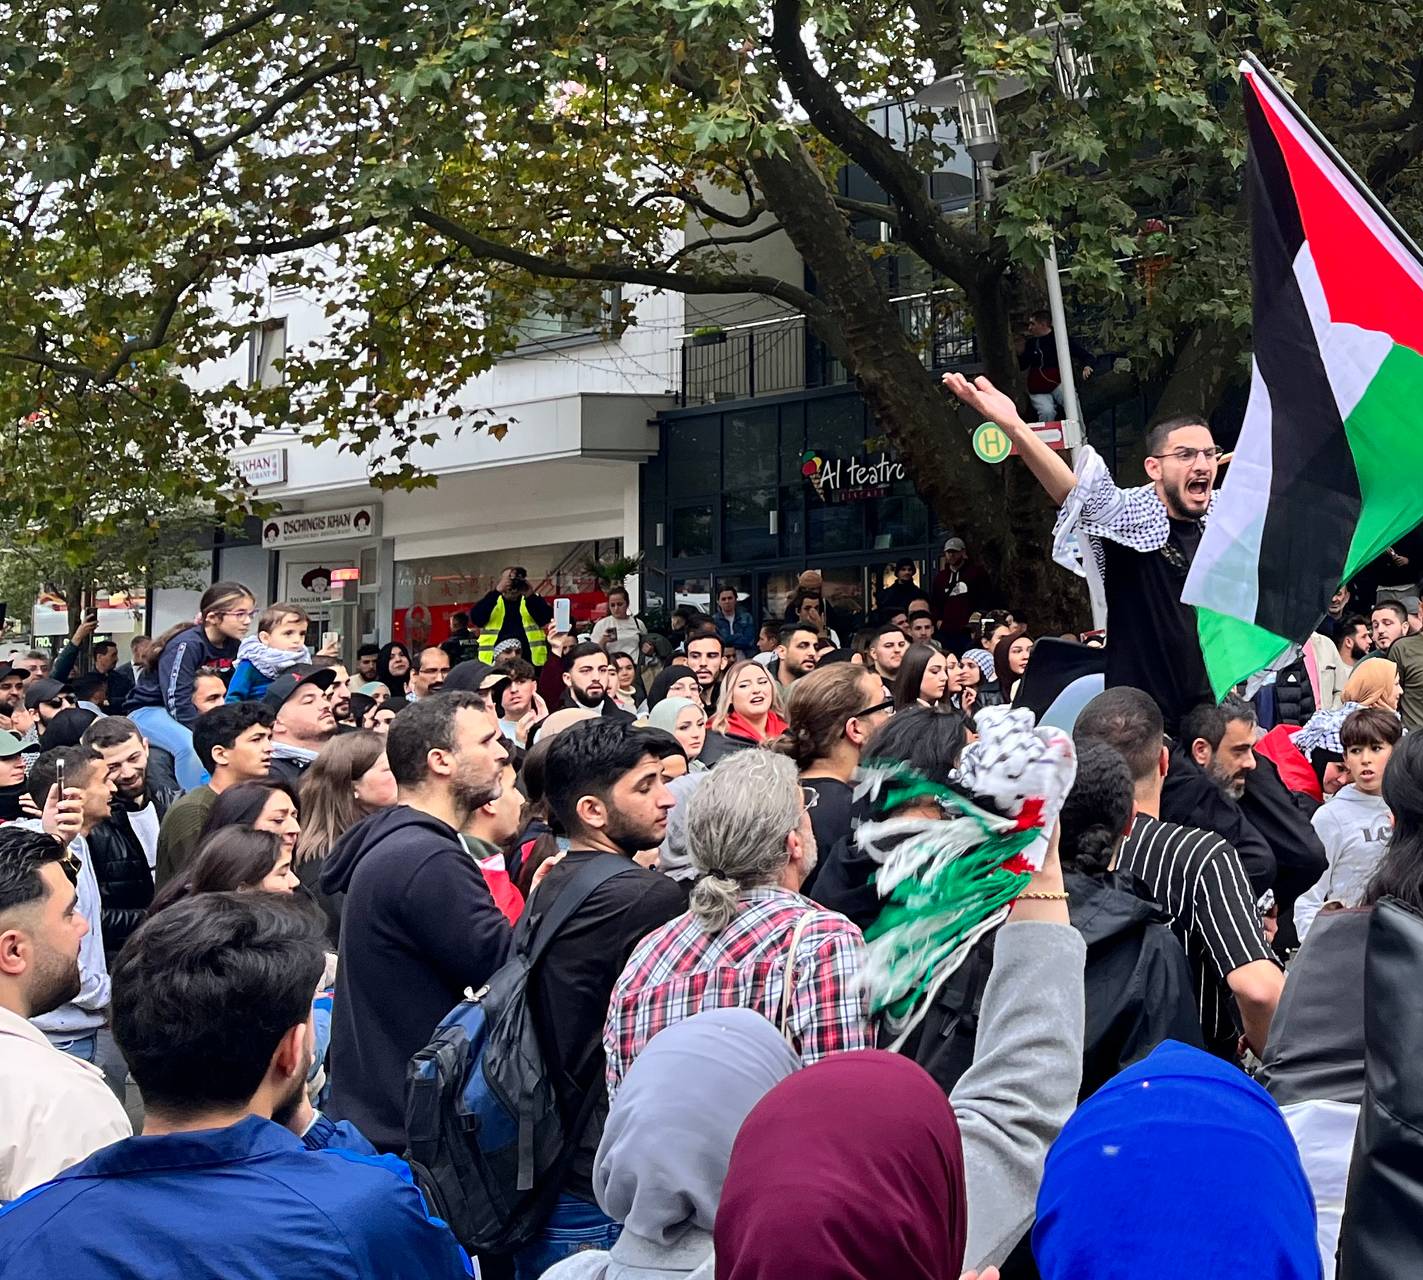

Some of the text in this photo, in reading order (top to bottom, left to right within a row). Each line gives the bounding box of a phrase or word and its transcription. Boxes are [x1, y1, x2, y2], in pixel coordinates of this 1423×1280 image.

[983, 431, 1000, 455] H
[243, 456, 271, 472] KHAN
[284, 512, 351, 535] DSCHINGIS KHAN
